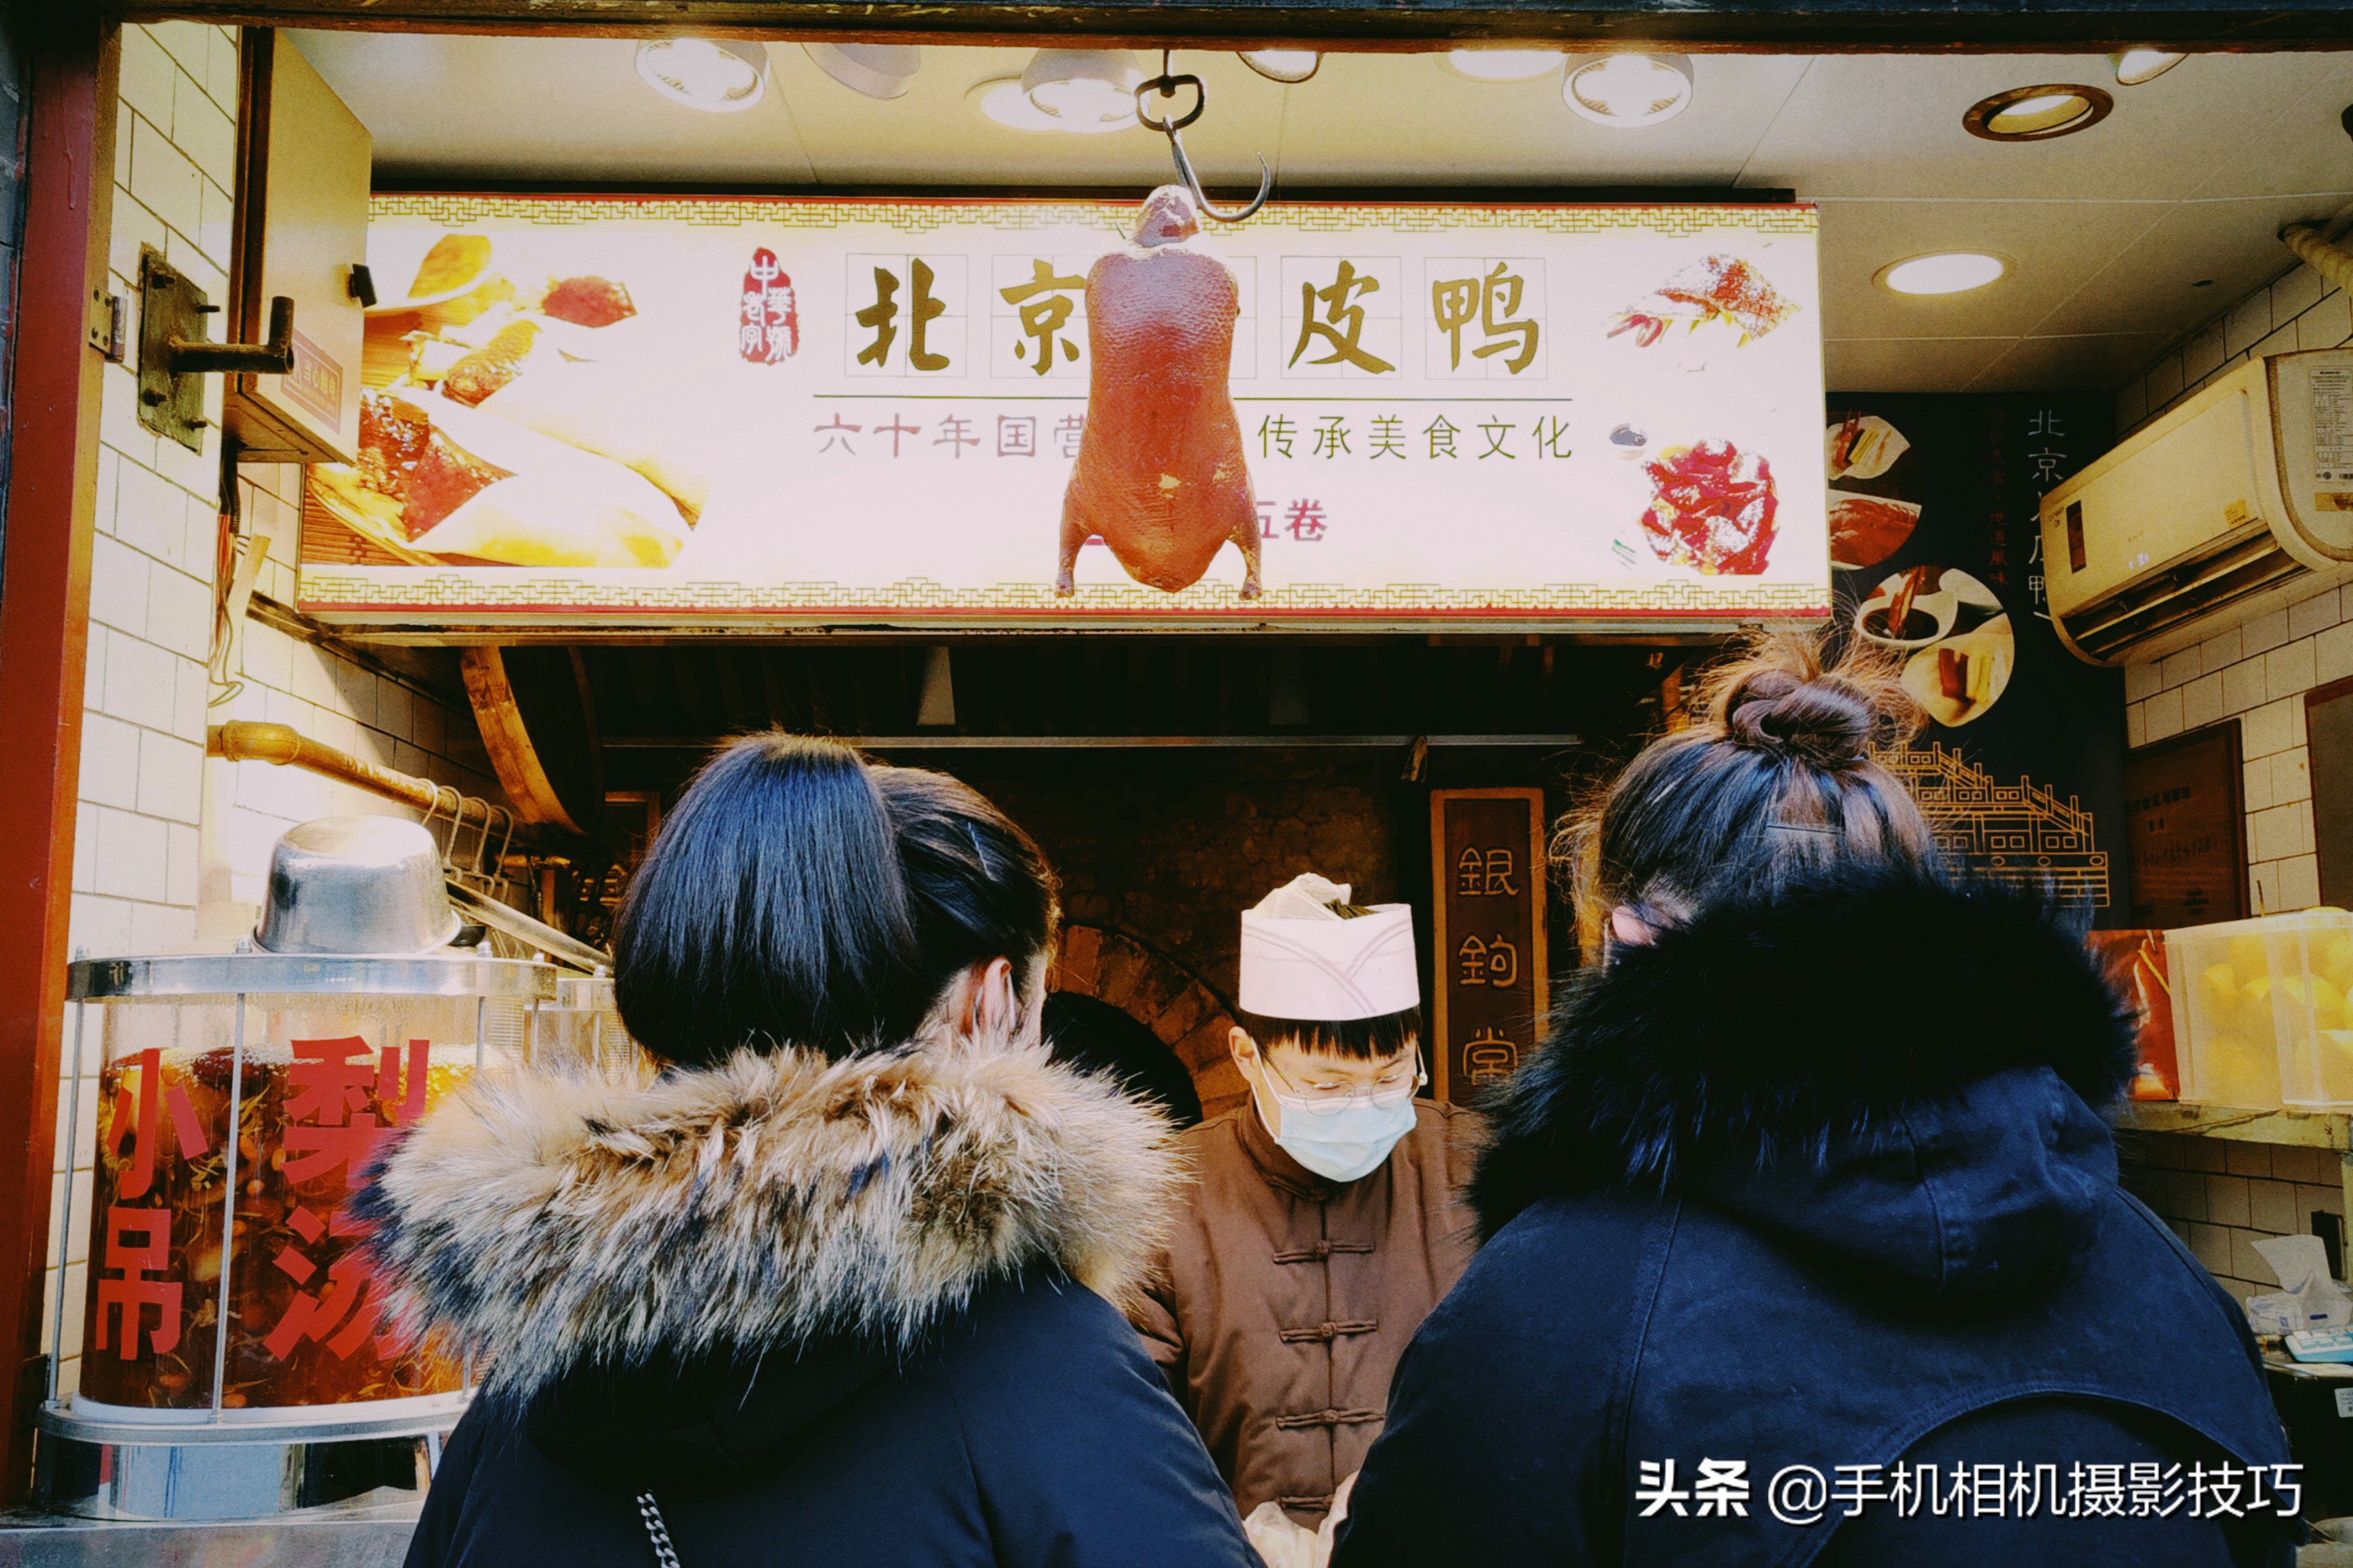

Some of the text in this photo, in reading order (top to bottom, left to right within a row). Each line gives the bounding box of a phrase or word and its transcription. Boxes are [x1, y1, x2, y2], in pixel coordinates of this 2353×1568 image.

[1258, 414, 1572, 459] 传承美食文化
[96, 1047, 209, 1360] 小吊
